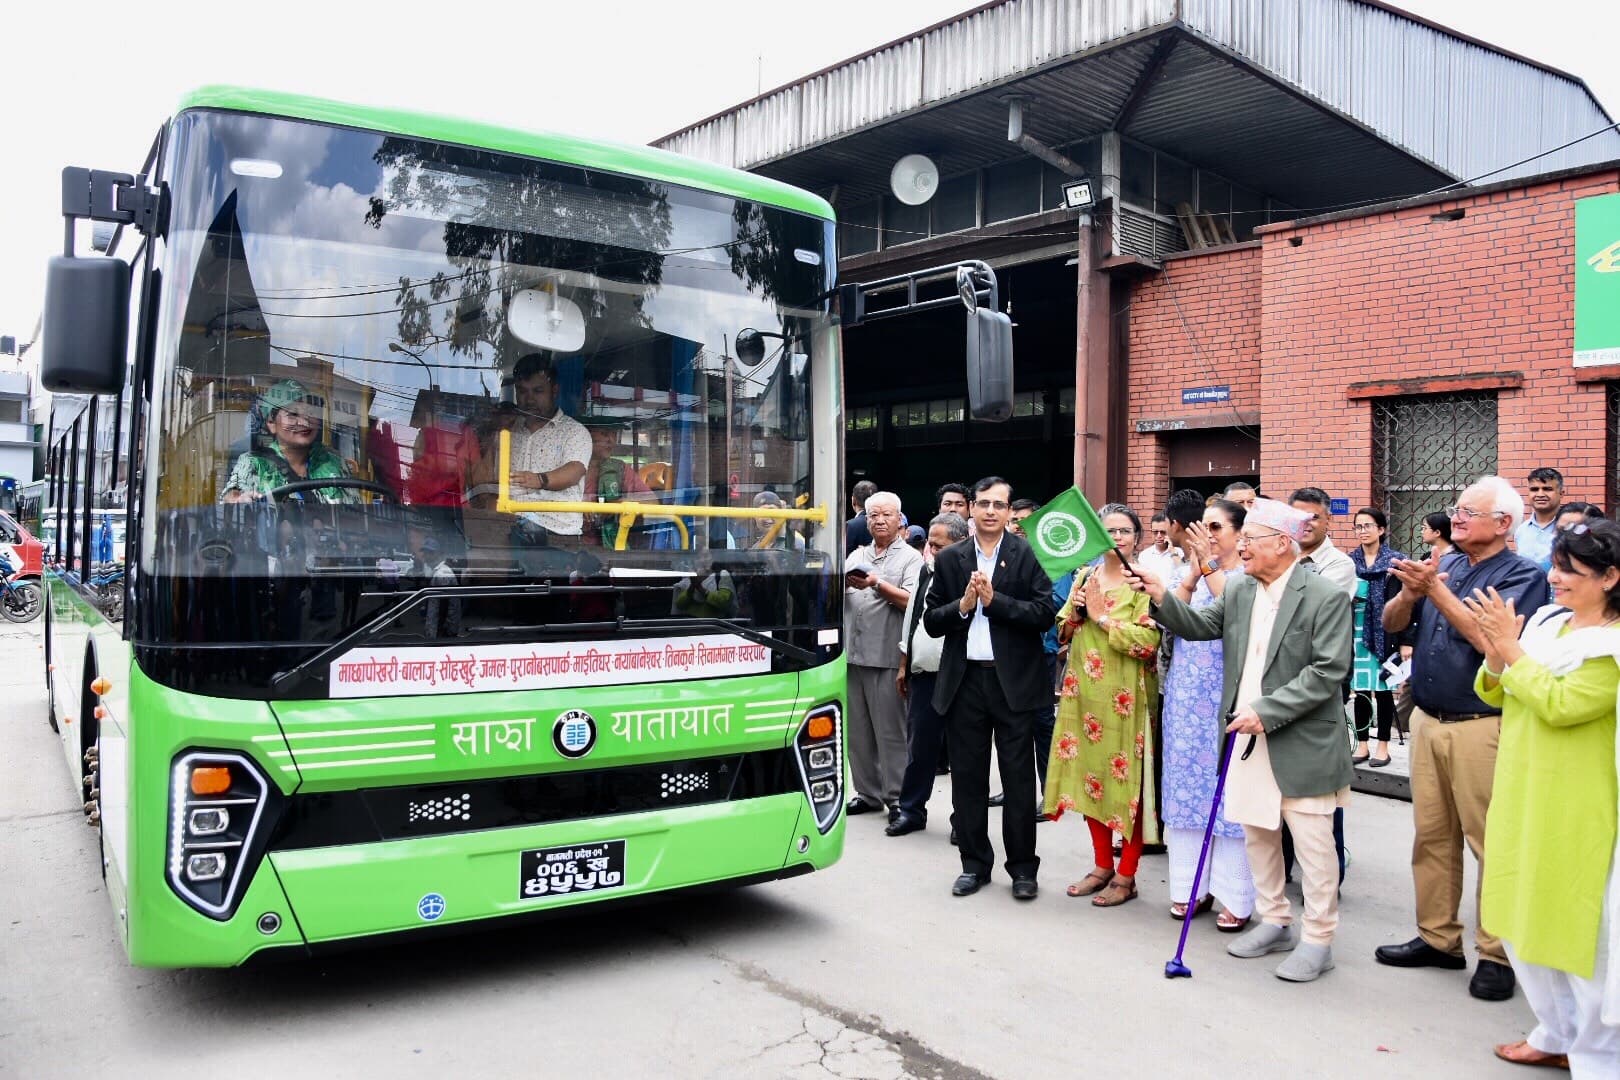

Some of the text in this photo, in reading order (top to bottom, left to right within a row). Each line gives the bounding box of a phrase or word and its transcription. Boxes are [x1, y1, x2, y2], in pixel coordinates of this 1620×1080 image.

[401, 661, 436, 686] बालाजु
[479, 659, 506, 678] जमल
[451, 704, 734, 756] साझा यातायात
[586, 856, 610, 871] ख
[525, 870, 621, 895] ४५५७
